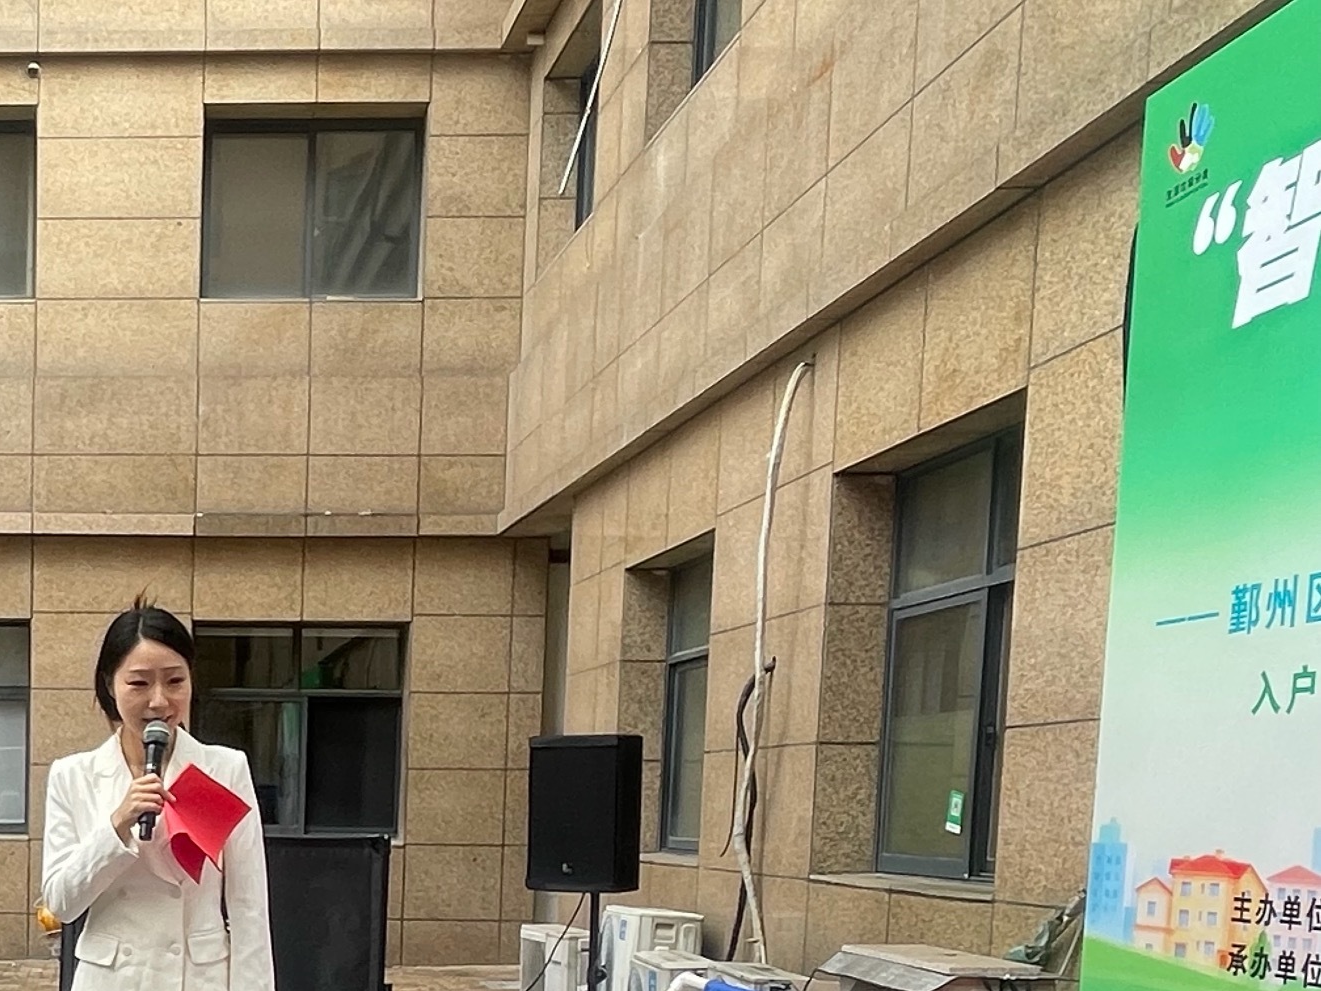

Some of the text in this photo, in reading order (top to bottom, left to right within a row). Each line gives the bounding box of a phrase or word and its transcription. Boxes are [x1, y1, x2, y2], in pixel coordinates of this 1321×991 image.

[1251, 665, 1317, 715] 入户
[1226, 943, 1321, 989] 承办单位
